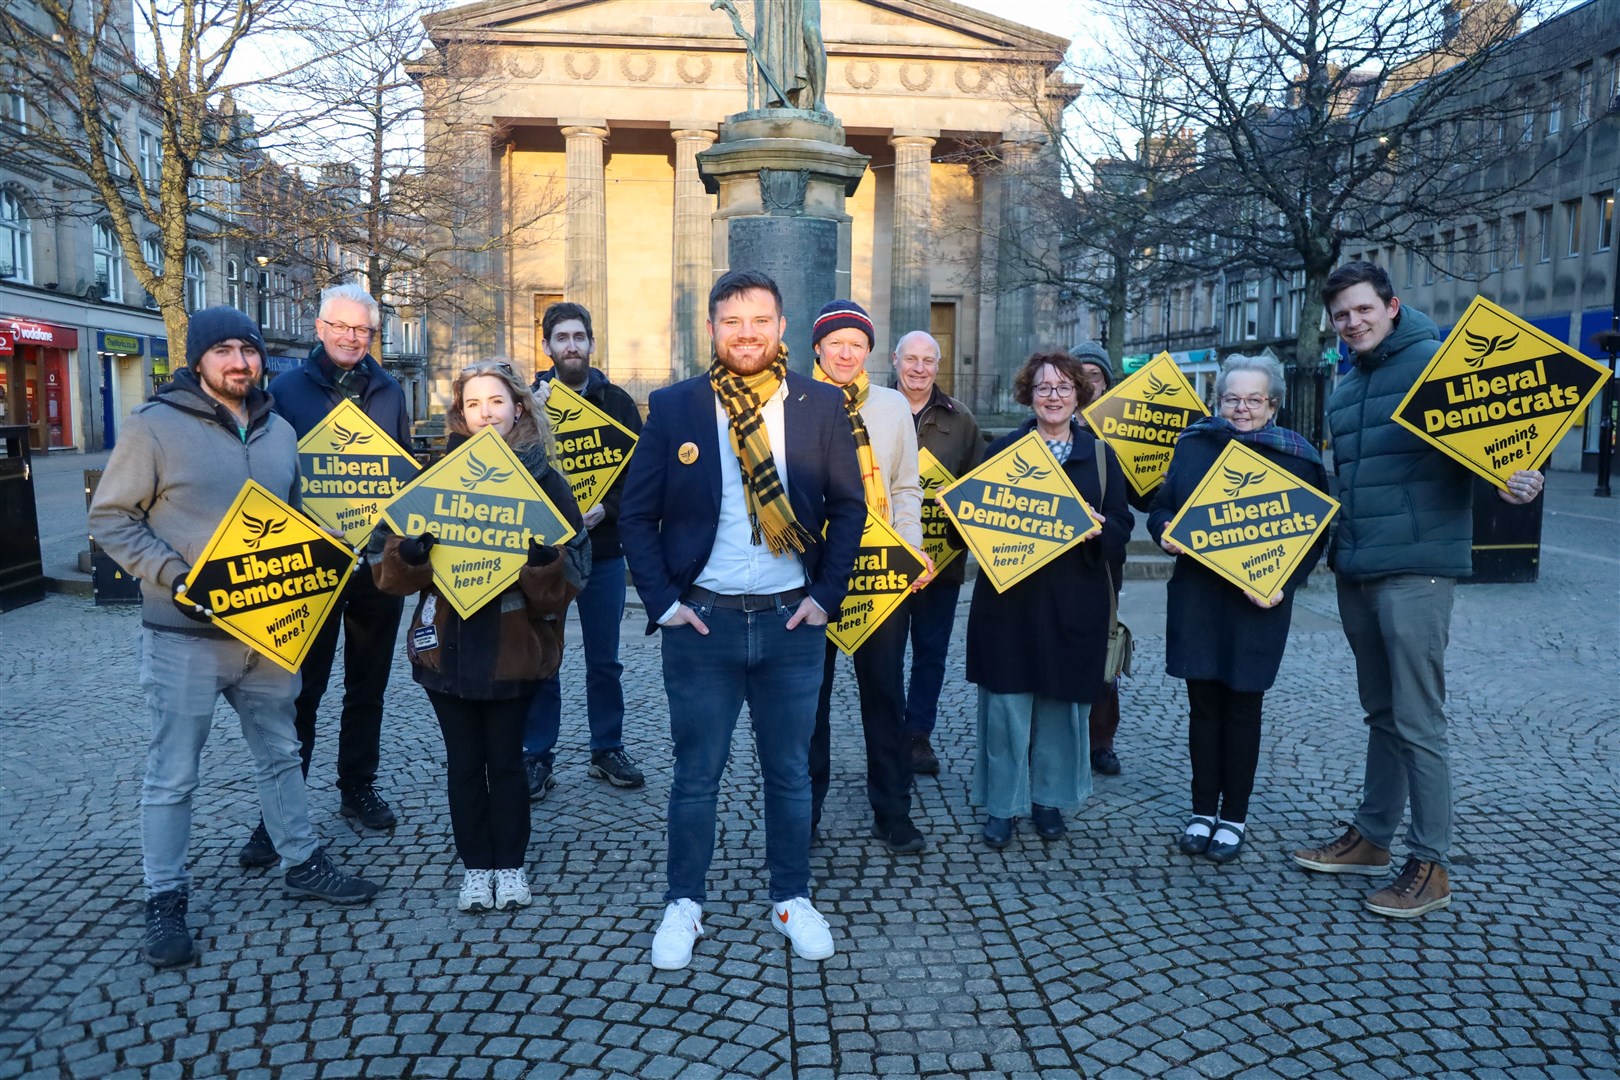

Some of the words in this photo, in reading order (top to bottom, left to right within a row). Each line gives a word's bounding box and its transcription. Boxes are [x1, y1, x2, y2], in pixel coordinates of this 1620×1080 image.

[21, 327, 53, 342] vodafone
[1445, 359, 1547, 405] Liberal
[1123, 402, 1190, 428] Liberal
[1423, 383, 1580, 433] Democrats
[1102, 416, 1181, 445] Democra
[1484, 423, 1539, 456] winning
[312, 455, 389, 476] Liberal
[1133, 451, 1170, 463] winning
[1135, 462, 1162, 474] here!
[1492, 440, 1531, 470] here!
[571, 474, 597, 493] nning
[336, 502, 378, 520] winning
[434, 493, 526, 526] Liberal
[982, 485, 1060, 517] Liberal
[1208, 492, 1291, 527] Liberal
[341, 514, 371, 532] here!
[957, 500, 1075, 540] Democrats
[1190, 512, 1318, 550] Democrats
[992, 542, 1035, 555] winning
[993, 554, 1026, 567] here!
[1241, 544, 1286, 570] winning
[226, 543, 314, 585] Liberal
[451, 556, 502, 574] winning
[1249, 558, 1281, 582] here!
[209, 566, 339, 614] Democrats
[454, 571, 492, 589] here!
[266, 602, 310, 635] winning
[841, 599, 874, 618] inning
[273, 619, 306, 648] here!
